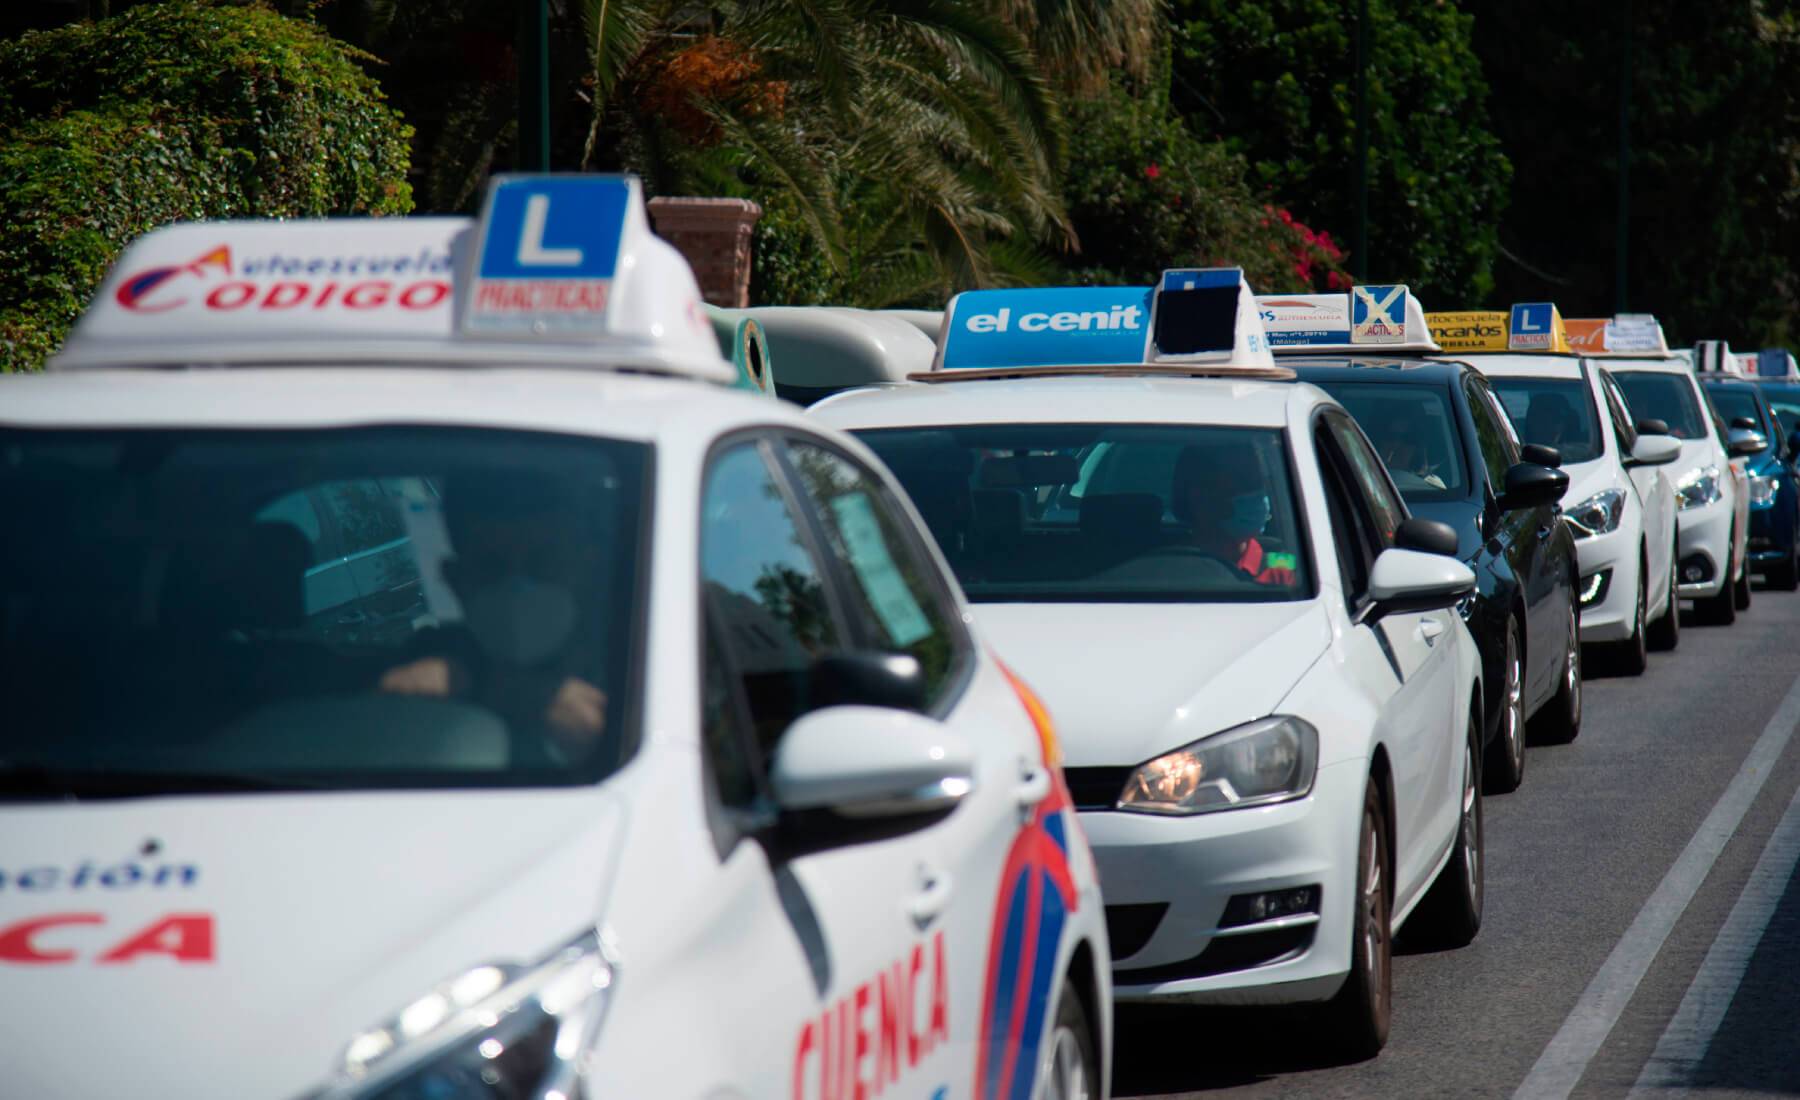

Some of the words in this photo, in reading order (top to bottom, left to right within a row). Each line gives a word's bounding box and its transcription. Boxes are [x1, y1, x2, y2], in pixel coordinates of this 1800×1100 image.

[517, 194, 582, 266] L
[965, 308, 1010, 333] el
[1018, 304, 1142, 332] cenit
[1521, 309, 1540, 331] L
[792, 927, 950, 1100] CUENCA
